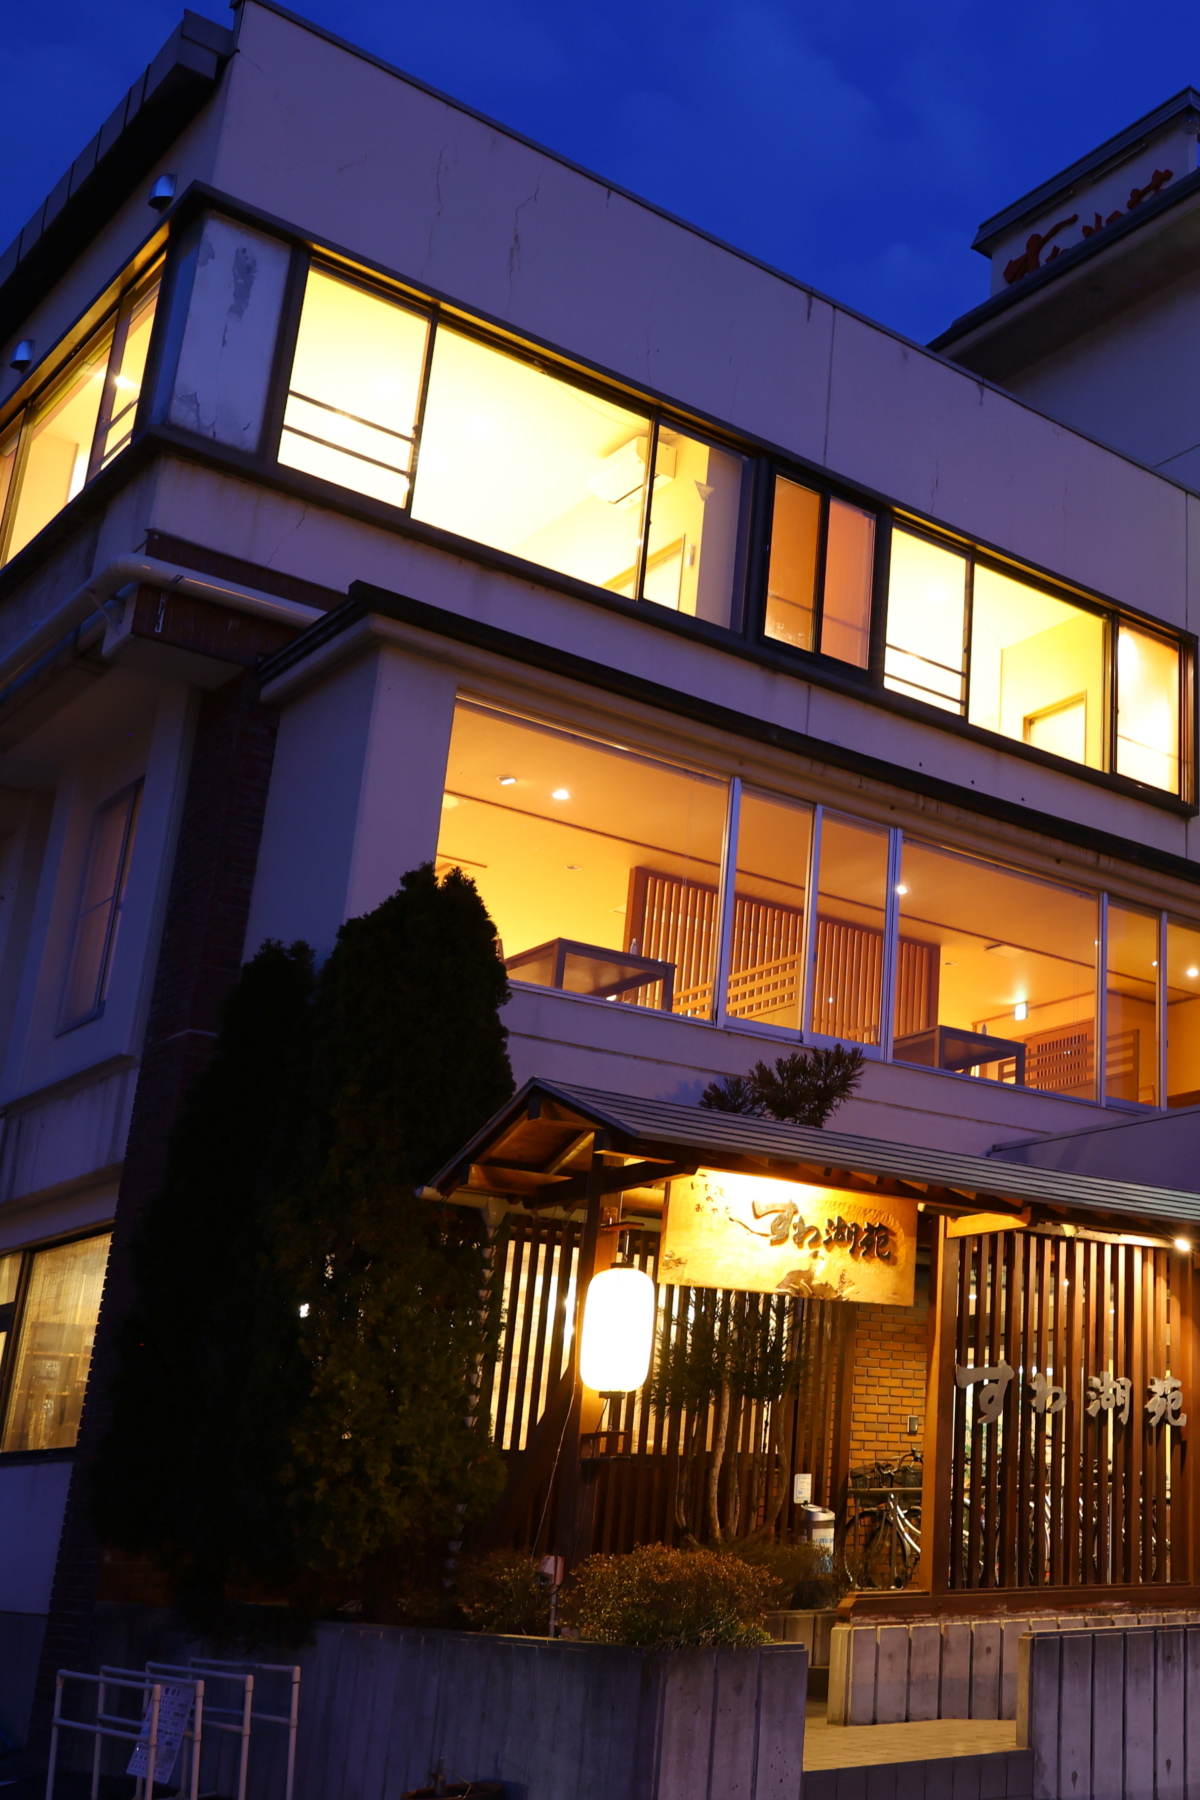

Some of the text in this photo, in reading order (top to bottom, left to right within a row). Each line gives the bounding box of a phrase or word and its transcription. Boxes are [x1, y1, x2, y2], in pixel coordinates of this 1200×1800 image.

[728, 1198, 892, 1259] すわ湖苑
[955, 1359, 1187, 1427] すわ湖苑
